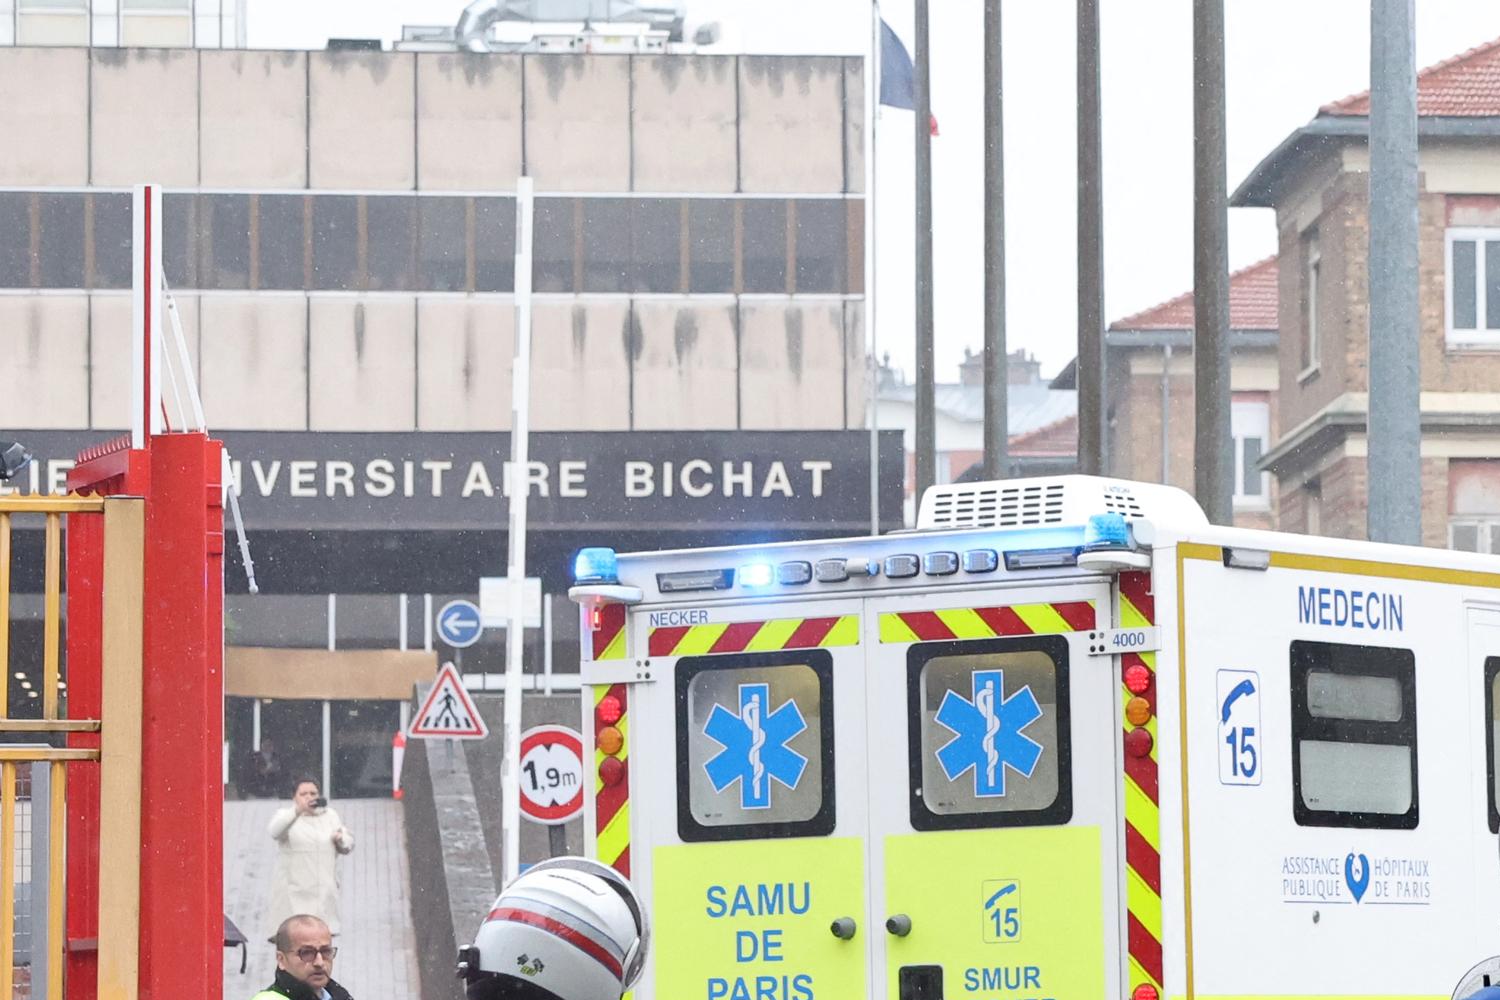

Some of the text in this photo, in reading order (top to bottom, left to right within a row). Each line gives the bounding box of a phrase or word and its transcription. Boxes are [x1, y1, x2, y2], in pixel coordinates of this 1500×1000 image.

[231, 459, 588, 498] IVERSITAIRE
[625, 460, 833, 498] BICHAT
[650, 610, 708, 627] NECKER
[1299, 586, 1404, 632] MEDECIN
[1113, 632, 1145, 647] 4000
[1226, 726, 1257, 778] 15
[1282, 857, 1340, 875] ASSISTANCE
[706, 881, 810, 918] SAMU
[1283, 879, 1340, 900] PUBLIQUE
[1375, 881, 1431, 898] DE PARIS
[990, 907, 1019, 938] 15
[736, 929, 784, 963] DE
[964, 966, 1041, 992] SMUR
